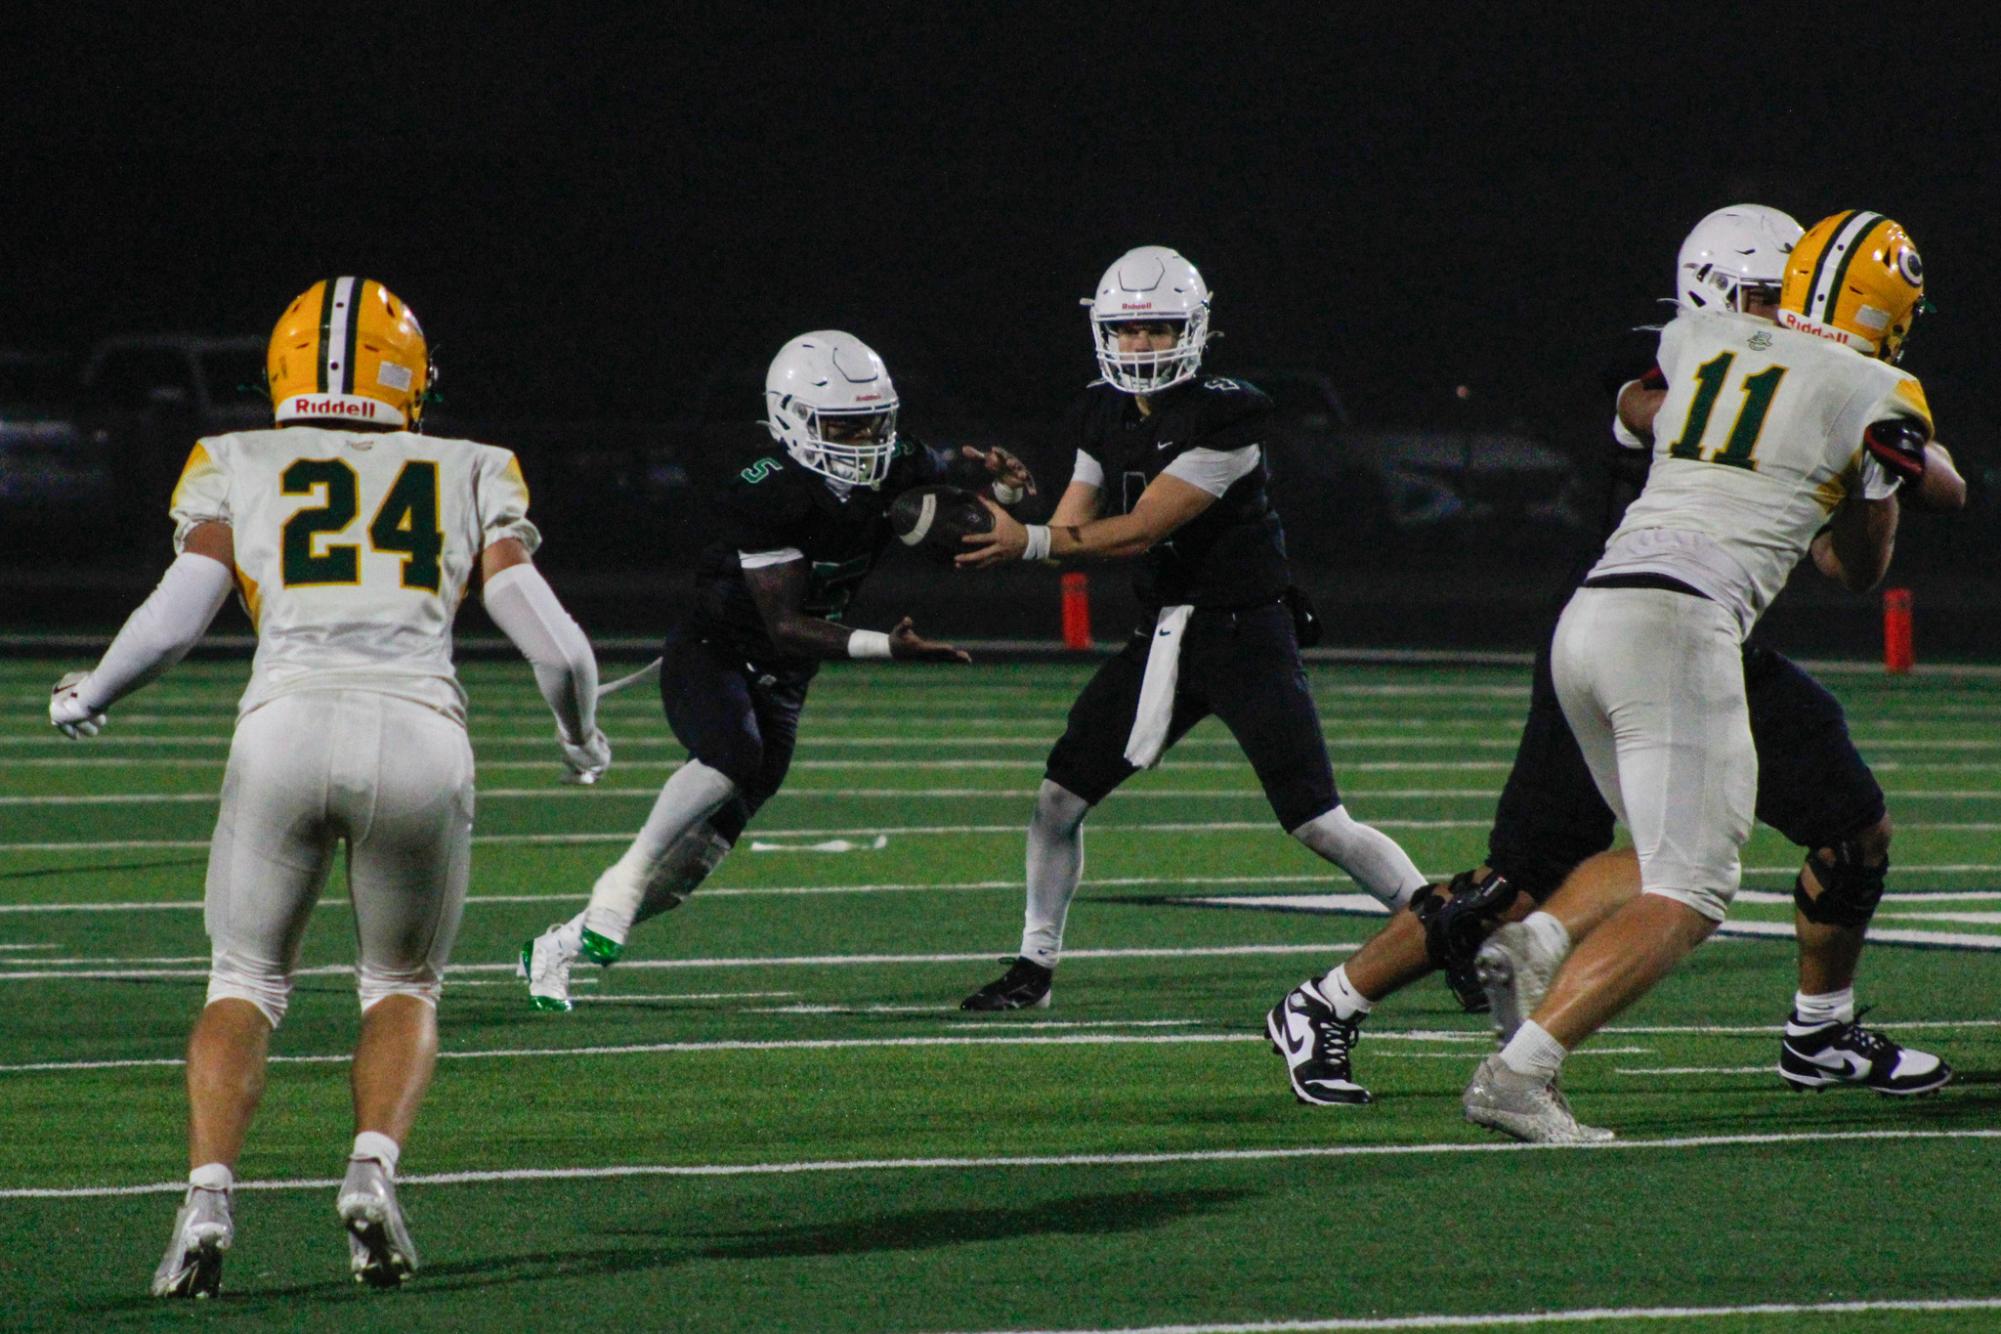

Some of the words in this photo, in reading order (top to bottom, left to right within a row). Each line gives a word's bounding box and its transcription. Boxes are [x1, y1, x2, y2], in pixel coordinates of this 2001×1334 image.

[295, 398, 376, 418] Riddell
[1670, 351, 1788, 471] 11
[740, 456, 784, 485] 5
[280, 457, 444, 595] 24
